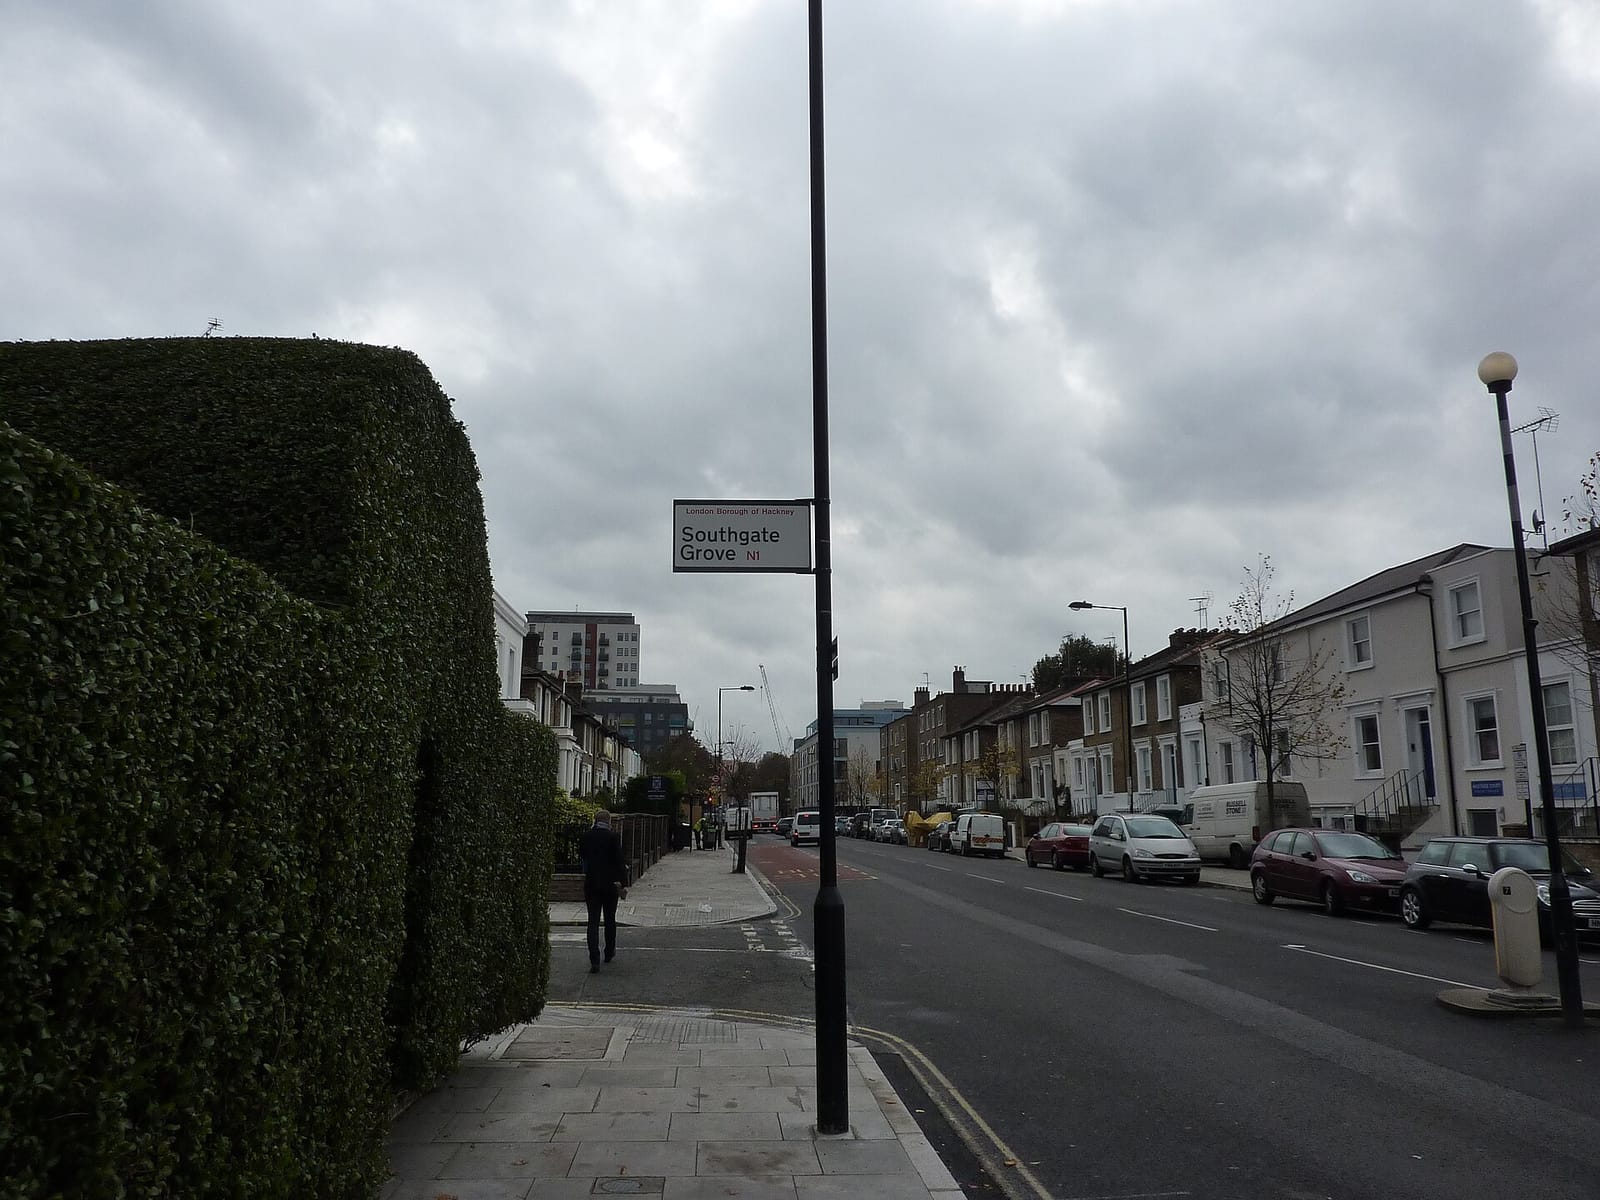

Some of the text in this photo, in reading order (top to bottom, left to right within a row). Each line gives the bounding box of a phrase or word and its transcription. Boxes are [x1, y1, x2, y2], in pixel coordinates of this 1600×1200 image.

[717, 508, 748, 516] Borough
[762, 508, 795, 516] Hackney
[682, 526, 780, 545] Southgate
[680, 544, 760, 561] Grove N1
